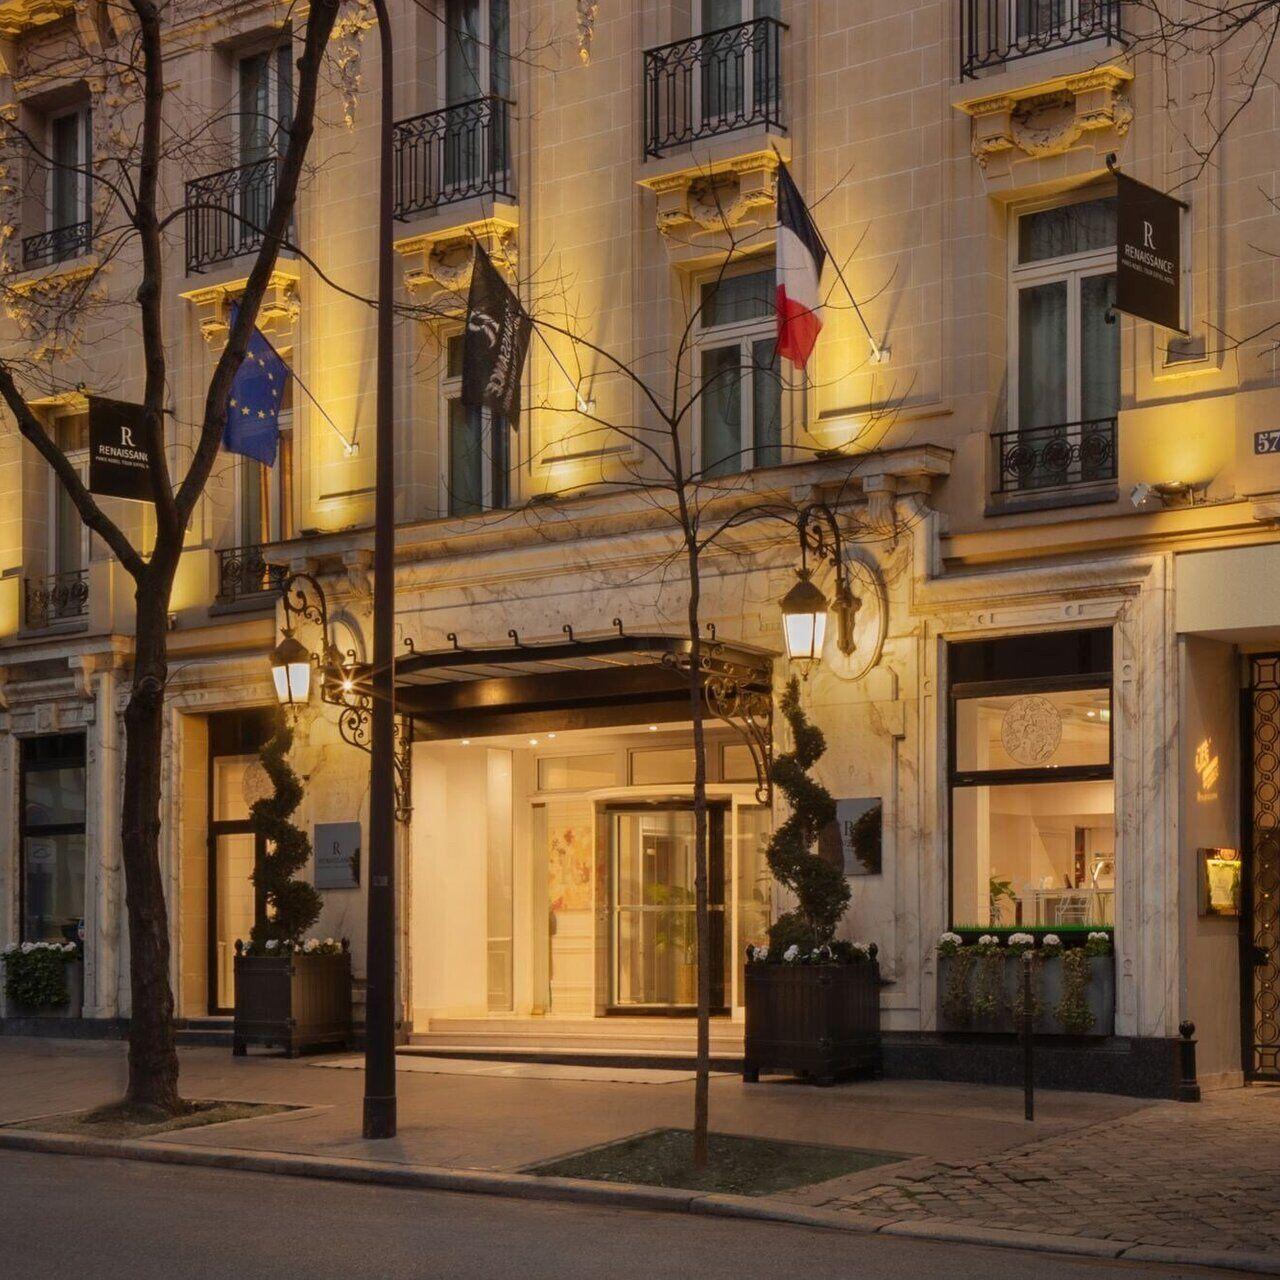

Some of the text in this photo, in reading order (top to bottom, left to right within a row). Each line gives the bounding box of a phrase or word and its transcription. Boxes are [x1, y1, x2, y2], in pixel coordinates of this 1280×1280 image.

[1143, 220, 1156, 250] R
[1124, 243, 1173, 274] RENAISSANCE
[120, 425, 136, 447] R
[331, 840, 342, 857] R
